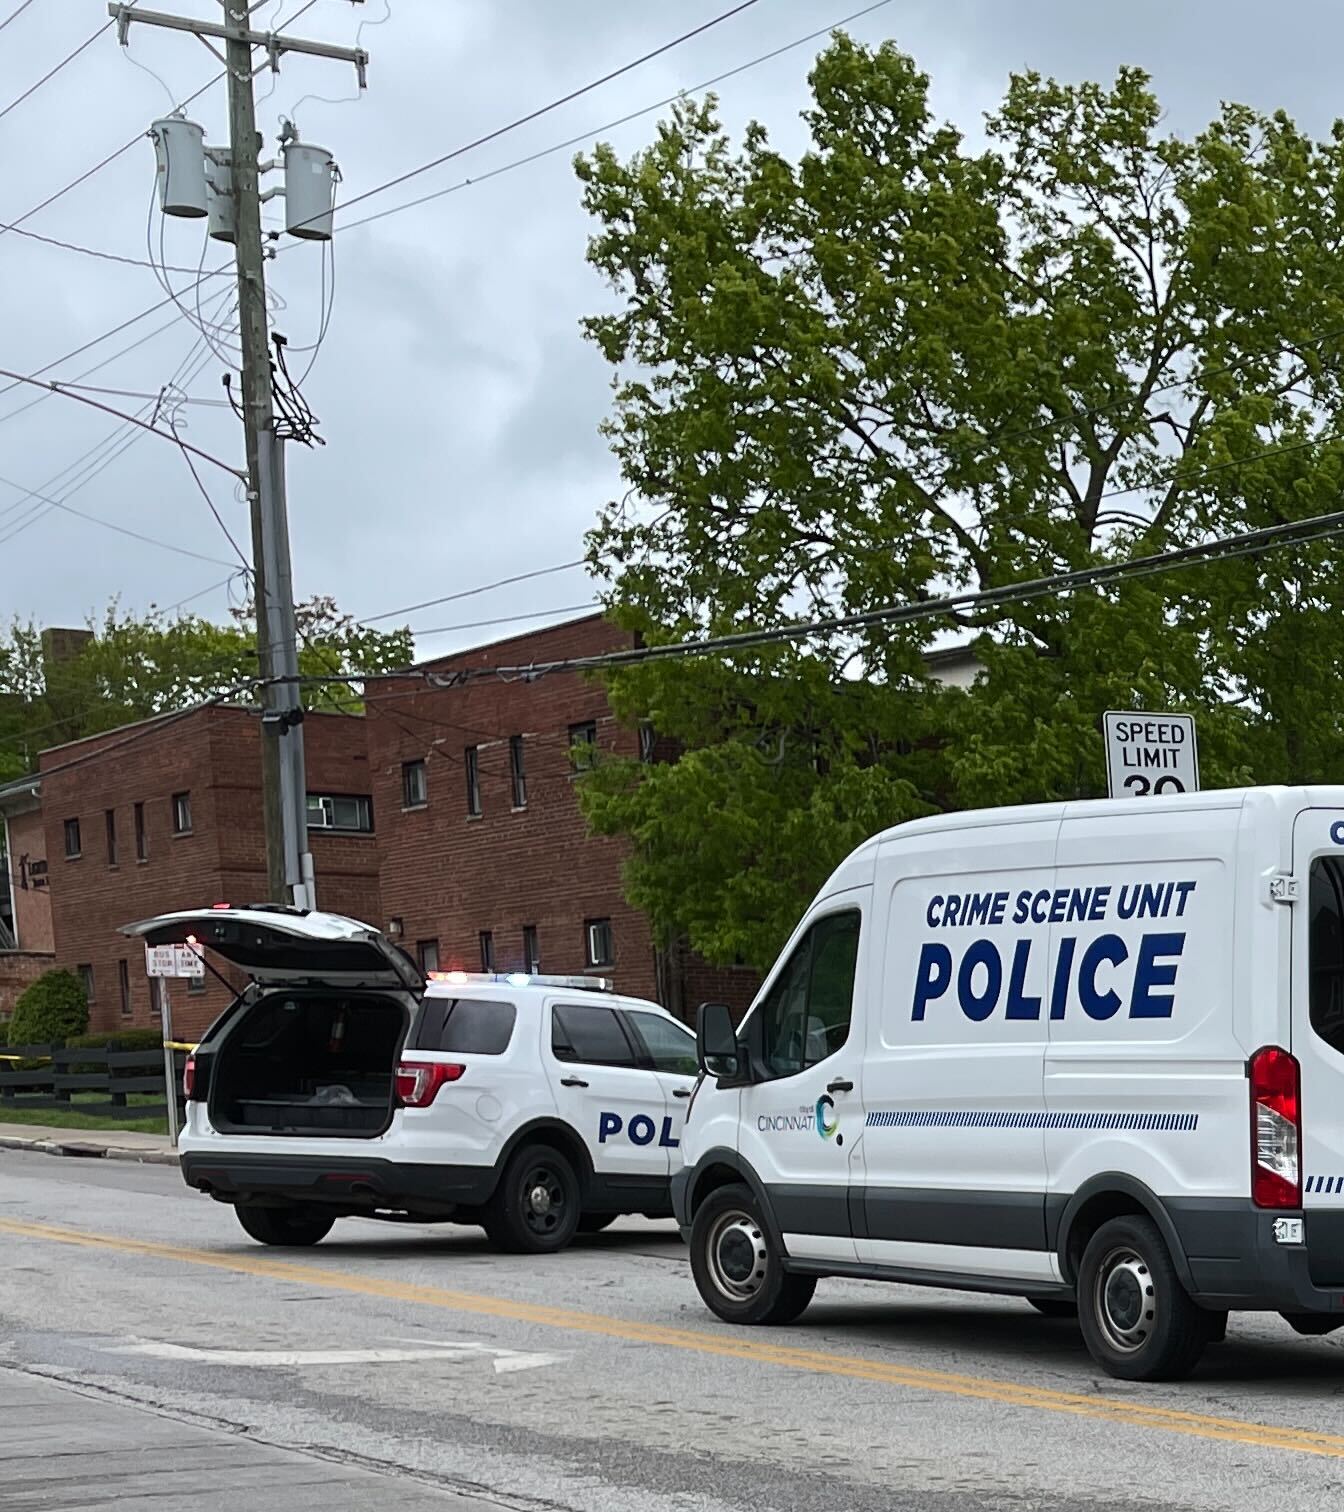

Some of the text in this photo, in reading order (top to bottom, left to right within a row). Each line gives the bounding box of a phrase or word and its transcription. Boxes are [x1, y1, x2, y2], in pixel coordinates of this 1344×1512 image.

[1115, 720, 1185, 744] SPEED
[1122, 746, 1181, 769] LIMIT
[926, 880, 1198, 928] CRIME SCENE UNIT
[910, 931, 1187, 1022] POLICE
[598, 1111, 681, 1148] POL
[757, 1115, 816, 1132] CINCINNATI
